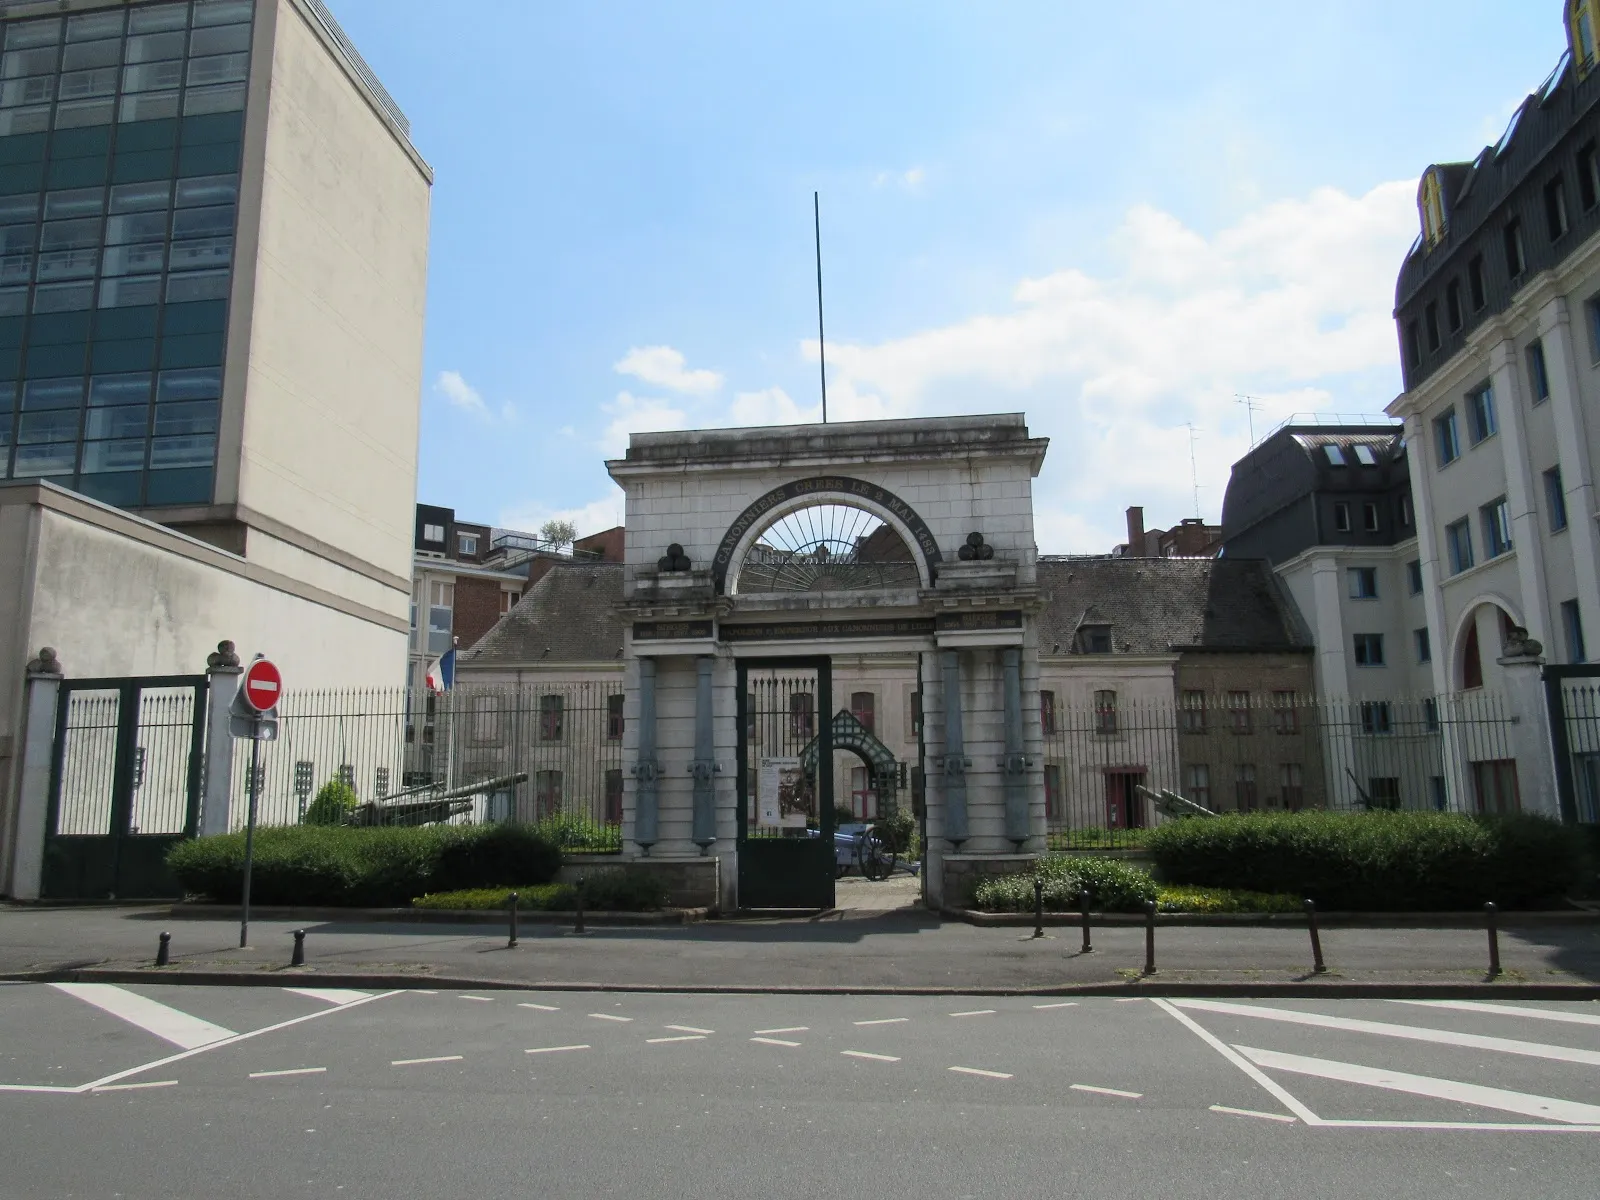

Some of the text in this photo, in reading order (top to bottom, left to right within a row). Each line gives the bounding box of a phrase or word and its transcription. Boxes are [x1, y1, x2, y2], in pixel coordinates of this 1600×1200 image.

[717, 489, 786, 564] CANONNIERS
[850, 481, 870, 495] LE
[888, 498, 915, 524] MAI
[915, 527, 936, 555] 1483
